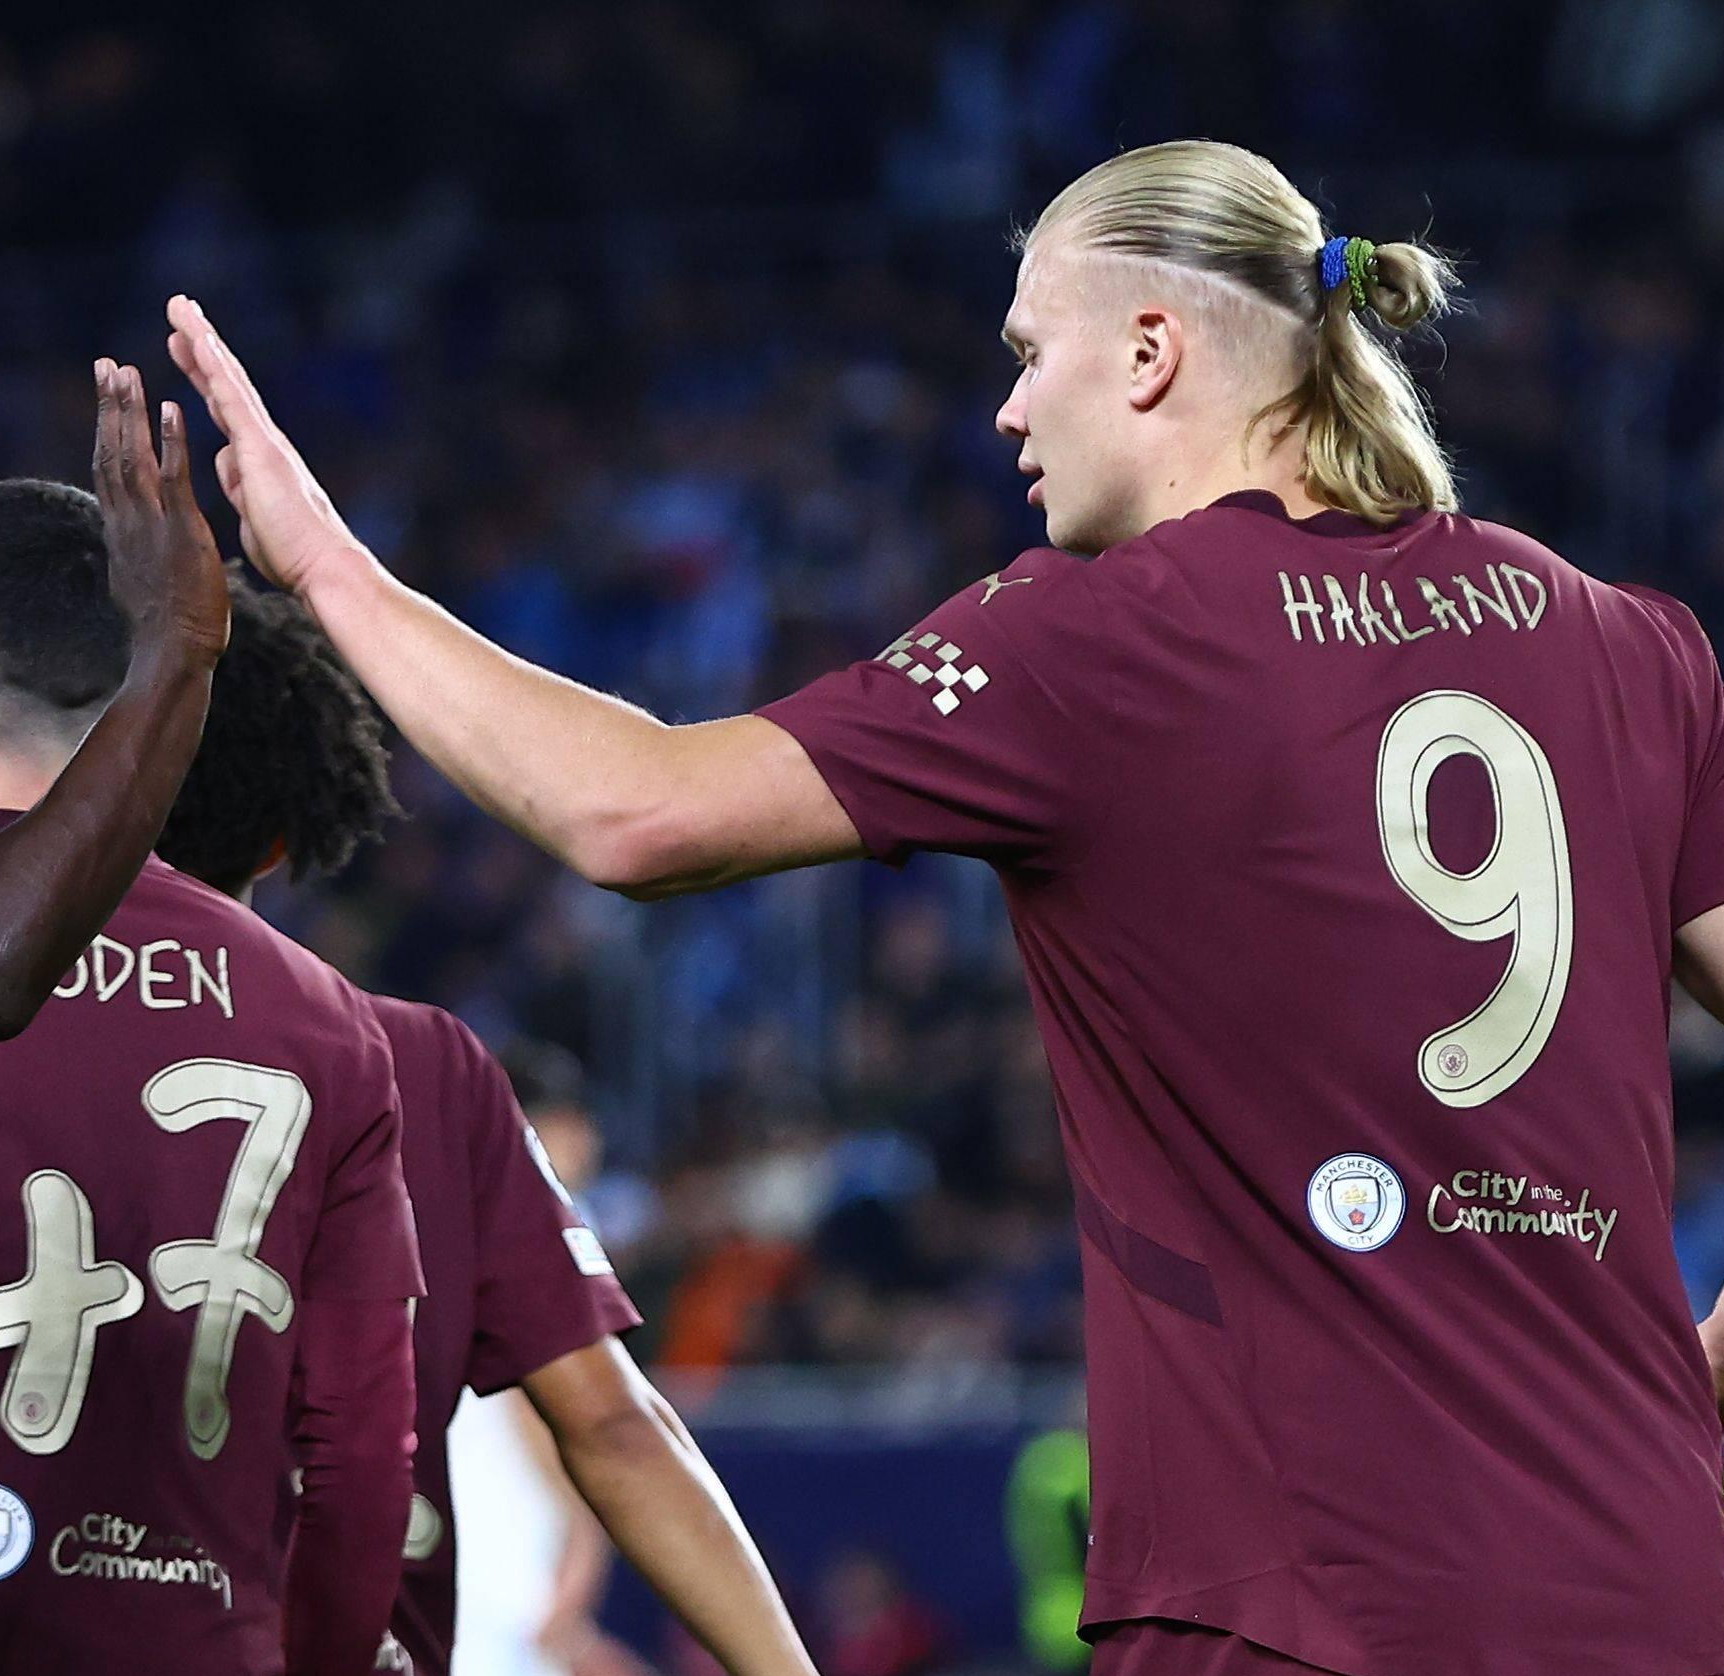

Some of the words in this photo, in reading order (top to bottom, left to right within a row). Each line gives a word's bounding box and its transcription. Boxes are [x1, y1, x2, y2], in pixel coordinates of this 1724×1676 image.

[1278, 562, 1547, 647] HAALAND
[1375, 688, 1575, 1108] 9
[52, 933, 234, 1019] ODEN
[1316, 1160, 1393, 1192] MANCHESTER
[1452, 1170, 1527, 1205] City
[1531, 1186, 1543, 1199] in
[1348, 1235, 1374, 1246] CITY
[1427, 1184, 1618, 1261] Community
[80, 1512, 147, 1552] City
